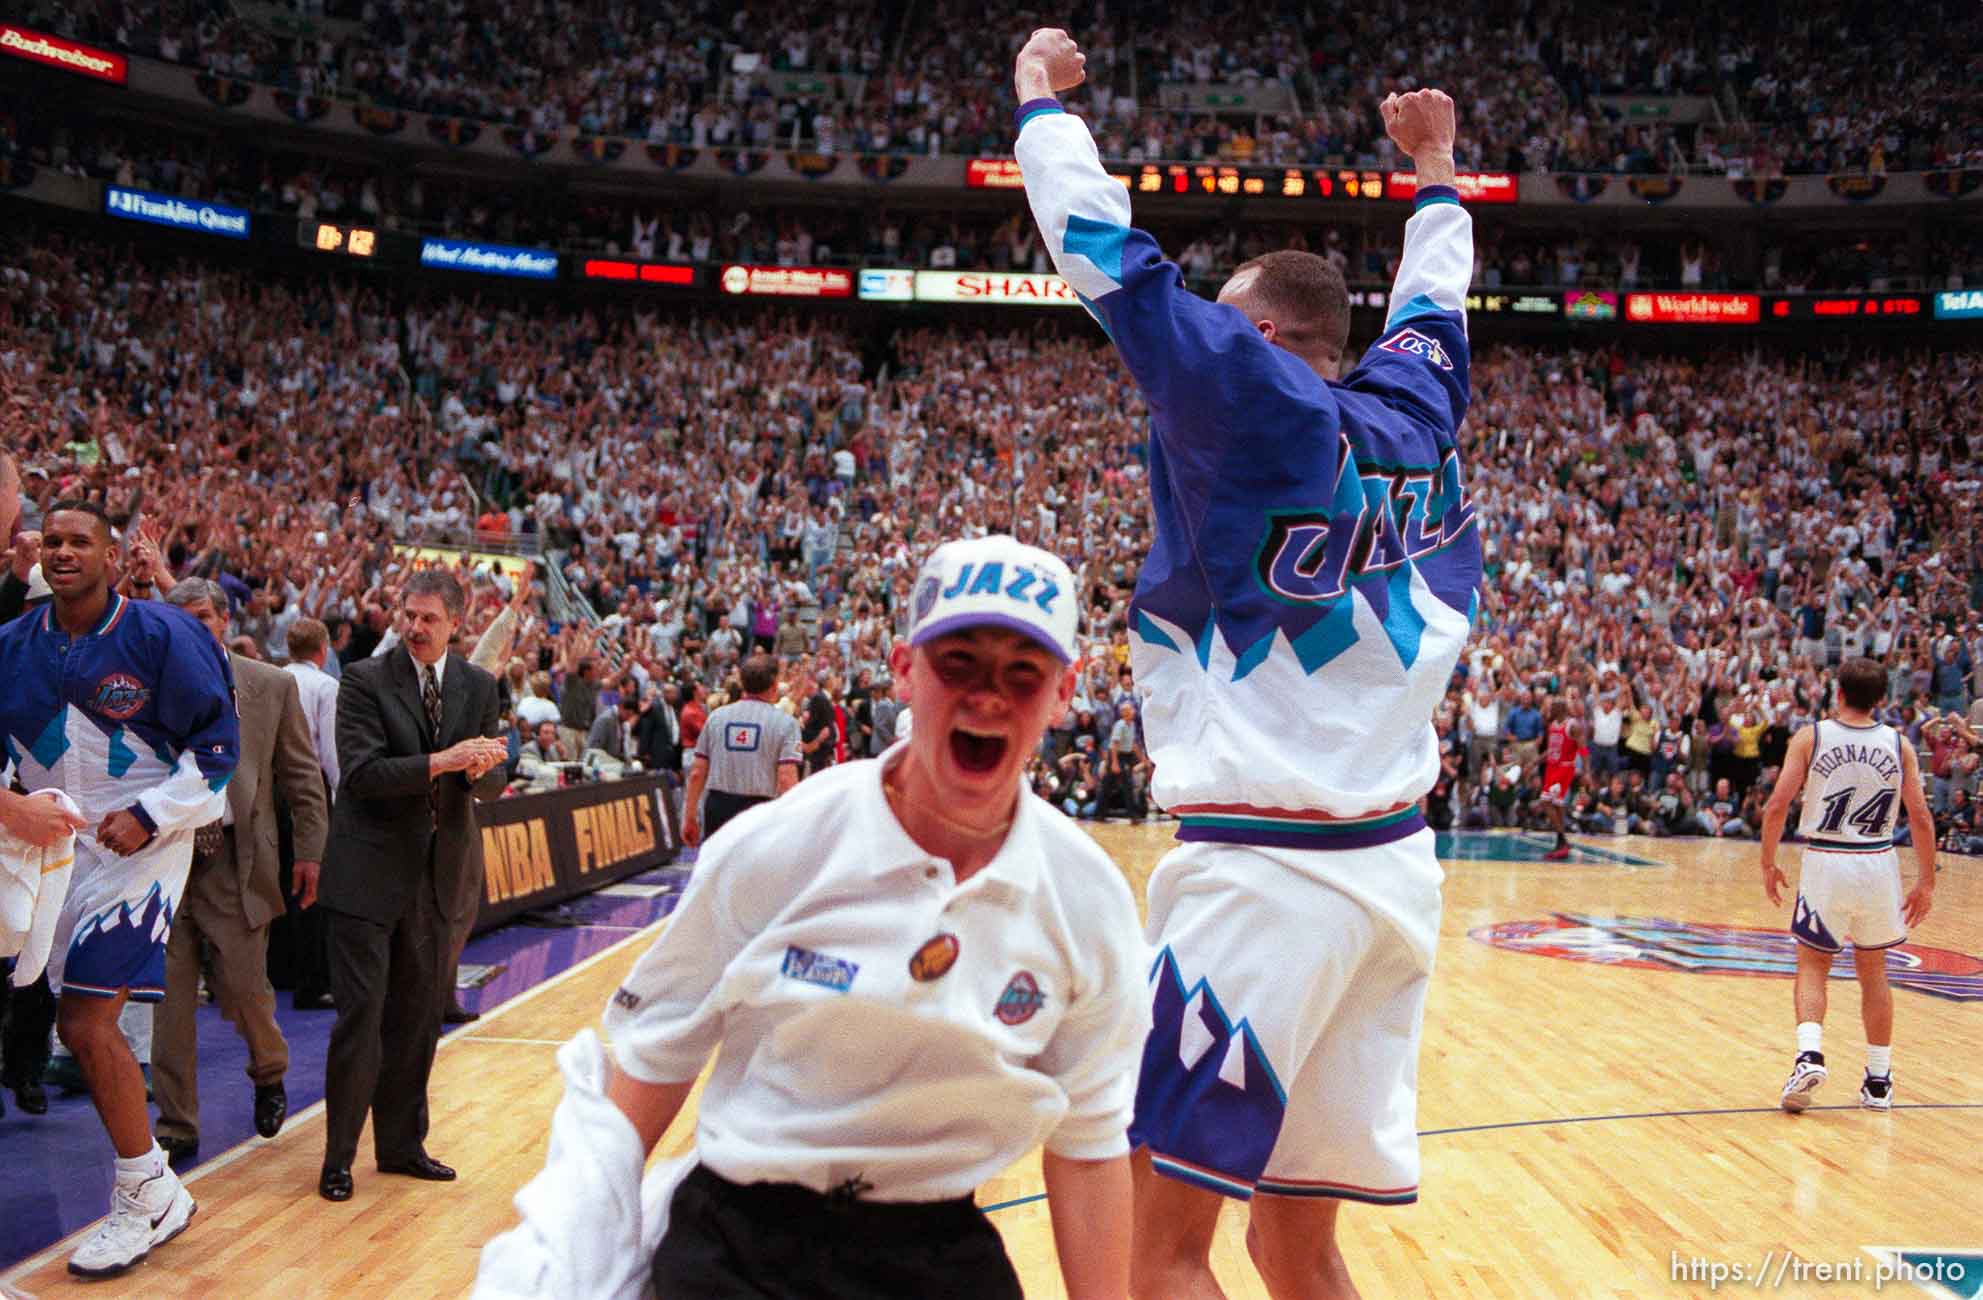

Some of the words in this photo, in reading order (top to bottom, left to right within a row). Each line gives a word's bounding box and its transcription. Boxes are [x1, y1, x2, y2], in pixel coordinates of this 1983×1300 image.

[956, 274, 1076, 299] SHAR
[943, 561, 1060, 614] JAZZ
[735, 730, 748, 745] 4
[1813, 743, 1900, 781] HORNACEK
[1817, 786, 1897, 836] 14
[481, 817, 556, 904] NBA
[571, 794, 656, 874] FINALS
